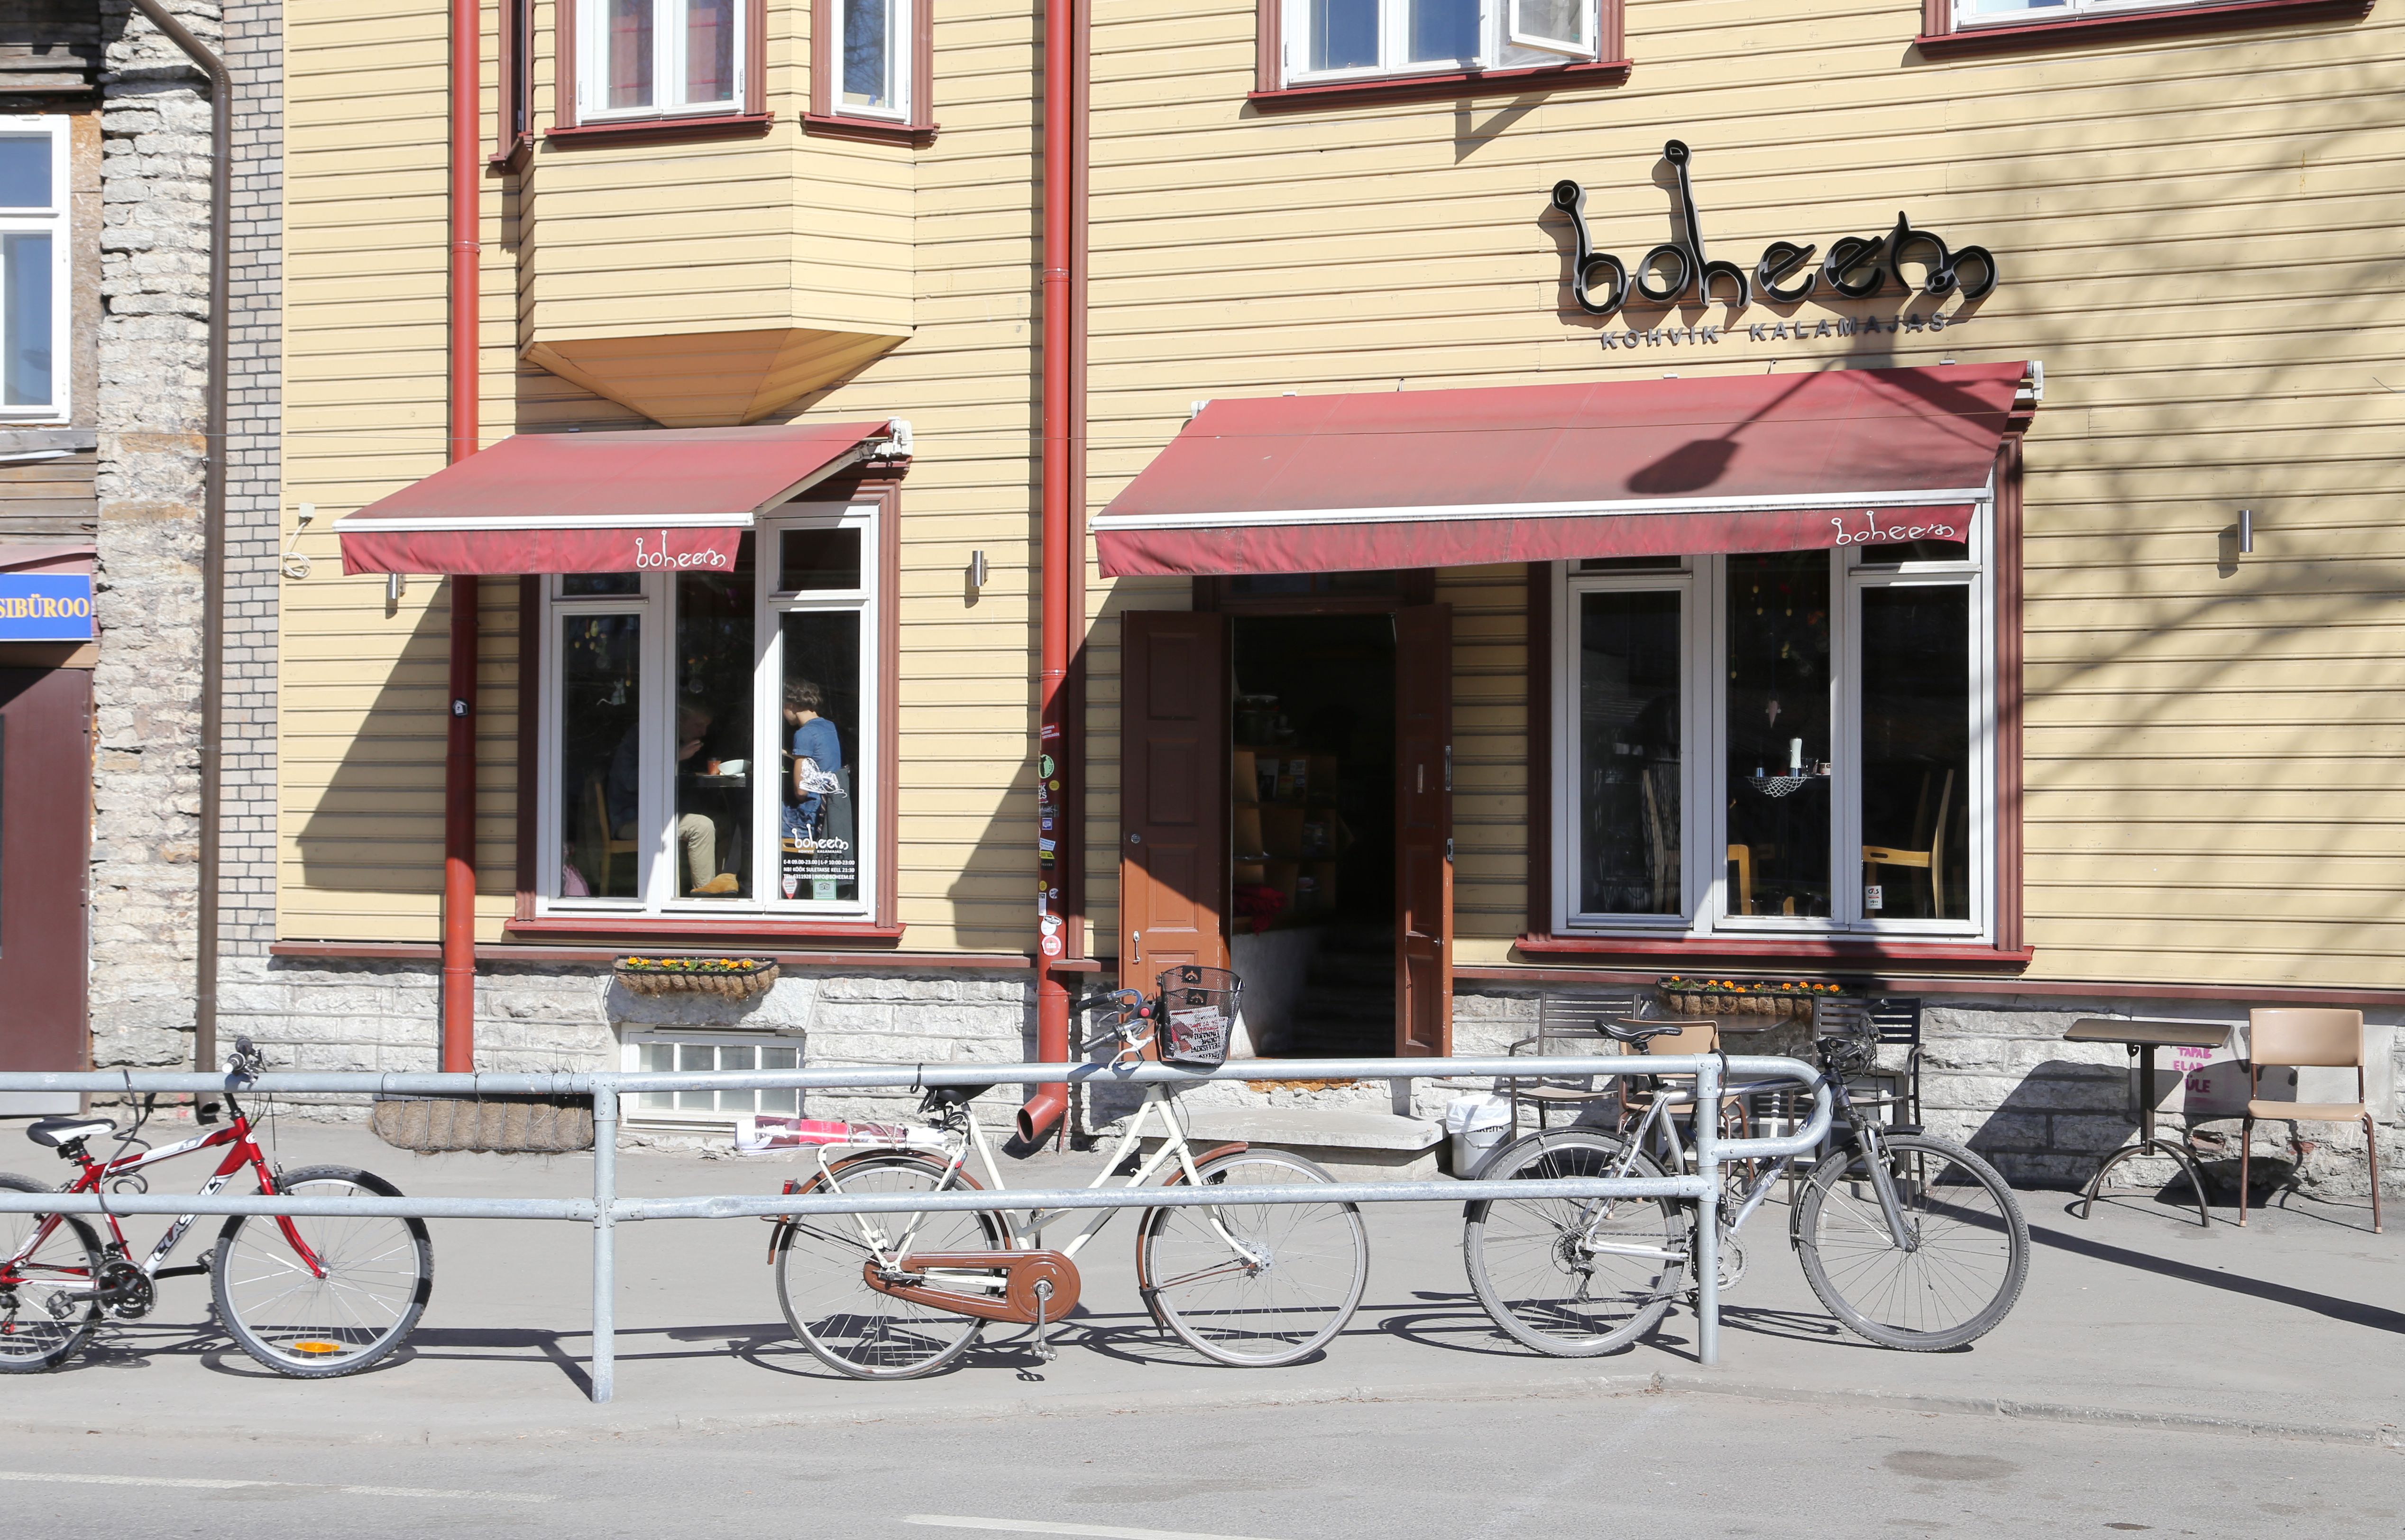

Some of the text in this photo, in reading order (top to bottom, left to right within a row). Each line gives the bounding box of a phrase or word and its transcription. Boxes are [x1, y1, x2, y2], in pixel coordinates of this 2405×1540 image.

[1551, 139, 1999, 315] boheem
[1601, 312, 1946, 350] KOHVIK KALAMAJAS
[1830, 510, 1955, 546] boheem
[635, 530, 726, 568] boheem
[791, 824, 849, 850] boheem
[2173, 1060, 2204, 1072] ELAD
[2185, 1075, 2211, 1093] ÜLE
